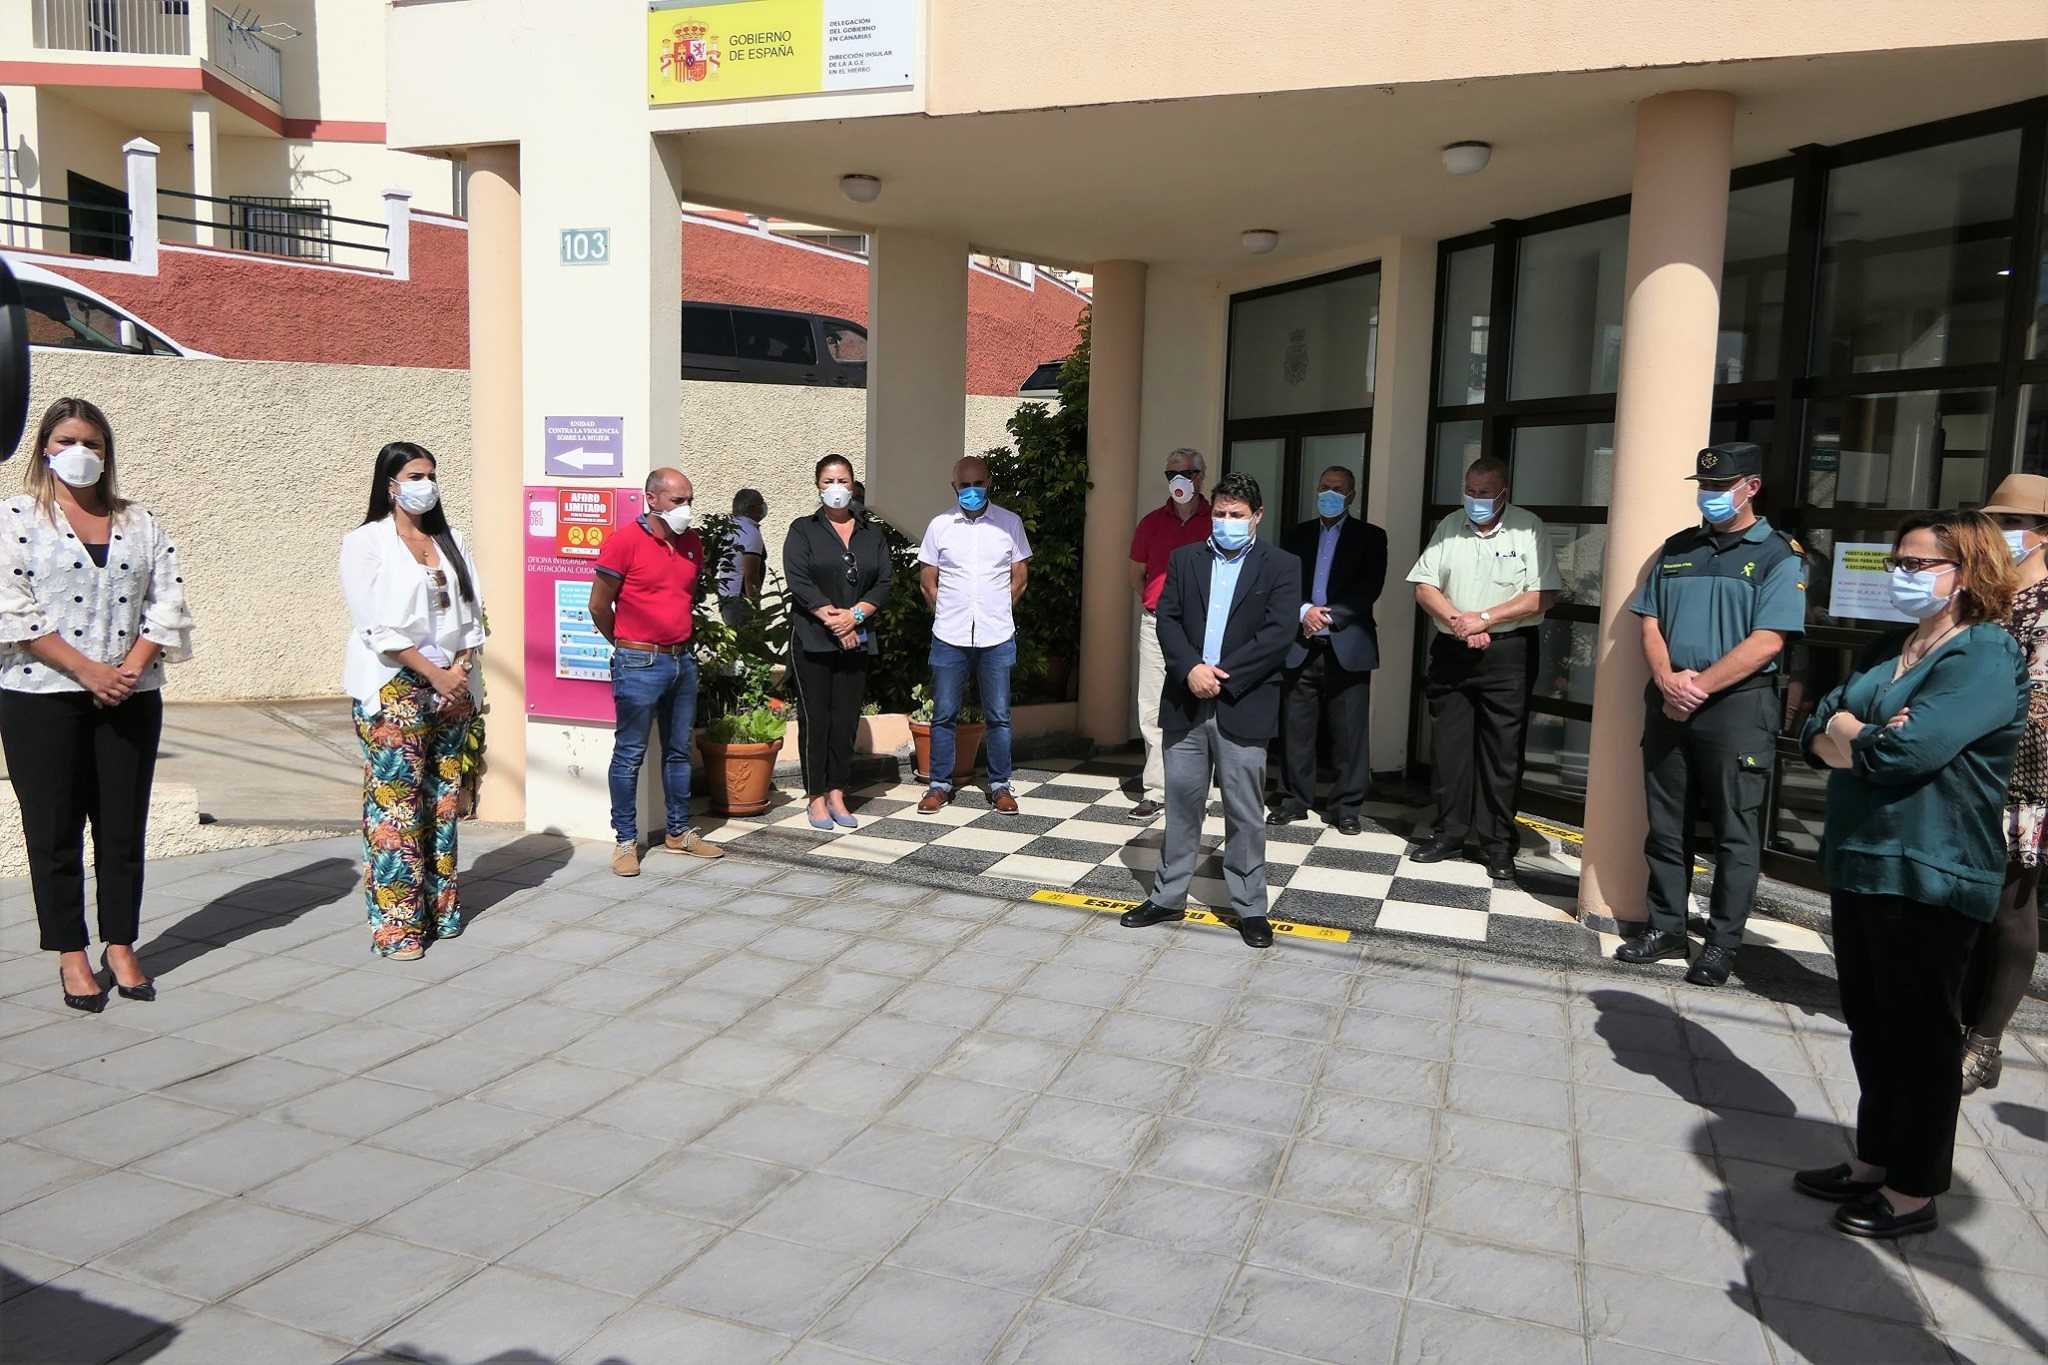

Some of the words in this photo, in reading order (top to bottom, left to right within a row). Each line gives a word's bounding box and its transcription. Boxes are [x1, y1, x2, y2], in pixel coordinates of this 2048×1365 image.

[842, 25, 877, 33] GOBIERNO
[729, 30, 791, 46] GOBIERNO
[839, 33, 872, 41] CANARIAS
[729, 49, 745, 61] DE
[748, 44, 794, 59] ESPAÑA
[565, 232, 605, 260] 103
[571, 492, 600, 503] AFORO
[564, 502, 607, 513] LIMITADO
[528, 556, 552, 564] OFICINA
[528, 564, 536, 572] DE
[576, 566, 597, 575] CIUDA
[1083, 898, 1139, 911] ESPE
